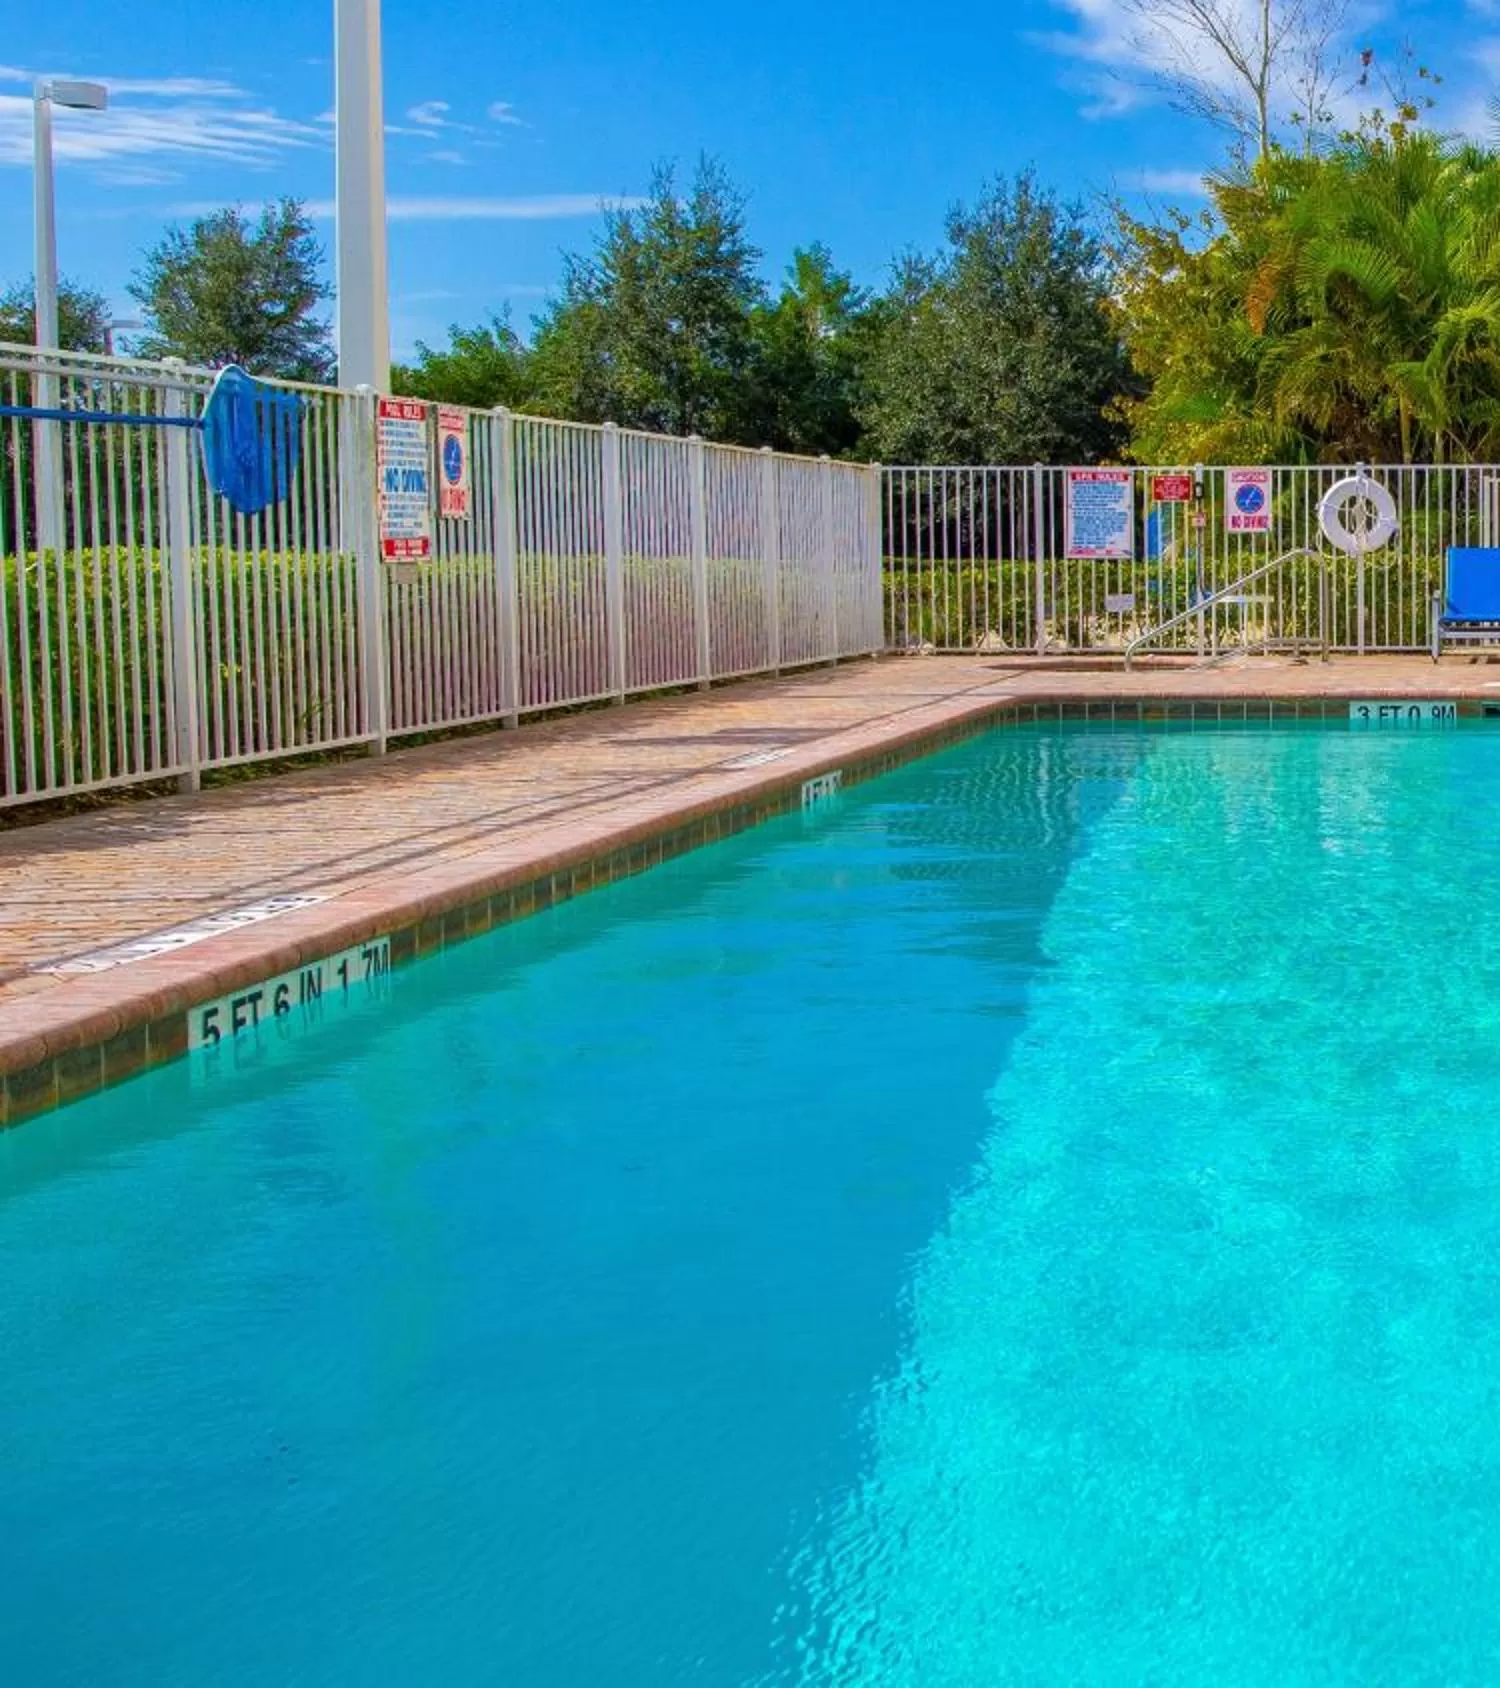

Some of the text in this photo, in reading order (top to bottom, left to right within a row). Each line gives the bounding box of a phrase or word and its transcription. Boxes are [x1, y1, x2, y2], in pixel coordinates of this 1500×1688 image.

[1231, 515, 1268, 528] NO DIVING
[1379, 705, 1402, 719] FT
[203, 1007, 221, 1048] 5
[231, 989, 262, 1036] FT
[274, 982, 290, 1017] 6
[299, 966, 323, 1006] IN
[337, 958, 348, 992] 1
